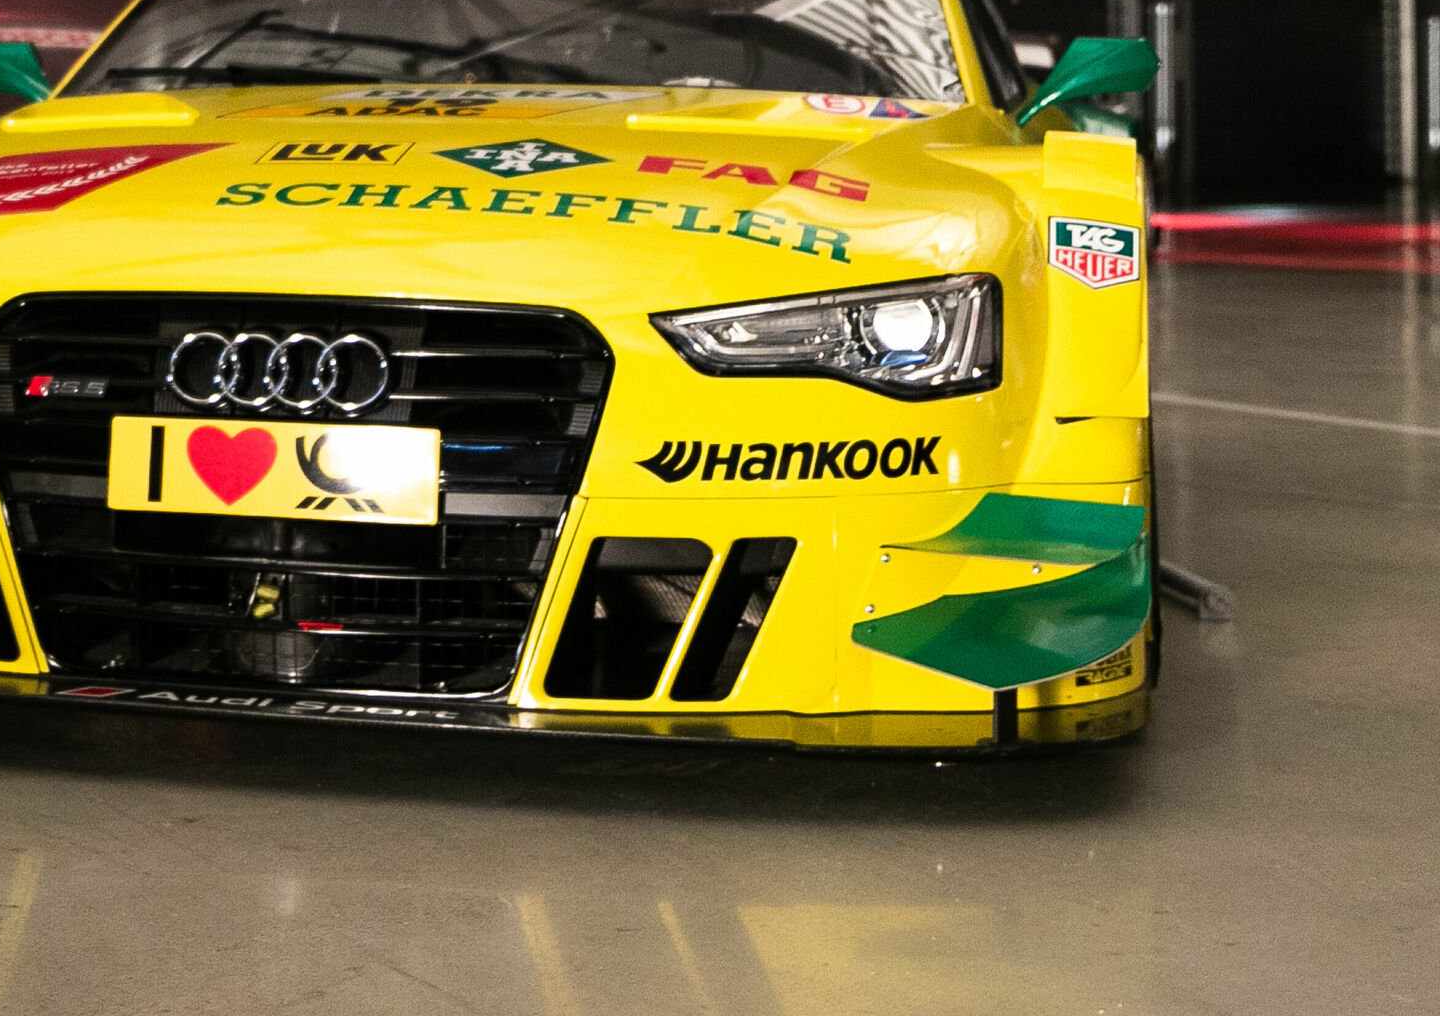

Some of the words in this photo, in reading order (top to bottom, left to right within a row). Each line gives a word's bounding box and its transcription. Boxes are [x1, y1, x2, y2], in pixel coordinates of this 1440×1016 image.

[306, 106, 488, 117] ADAC
[637, 155, 871, 202] FAG
[216, 181, 853, 265] SCHAEFFLER
[1066, 224, 1125, 253] TAG
[1058, 249, 1132, 281] HEUER
[148, 425, 166, 503] I
[138, 690, 274, 708] Audi
[290, 699, 460, 720] Sport
